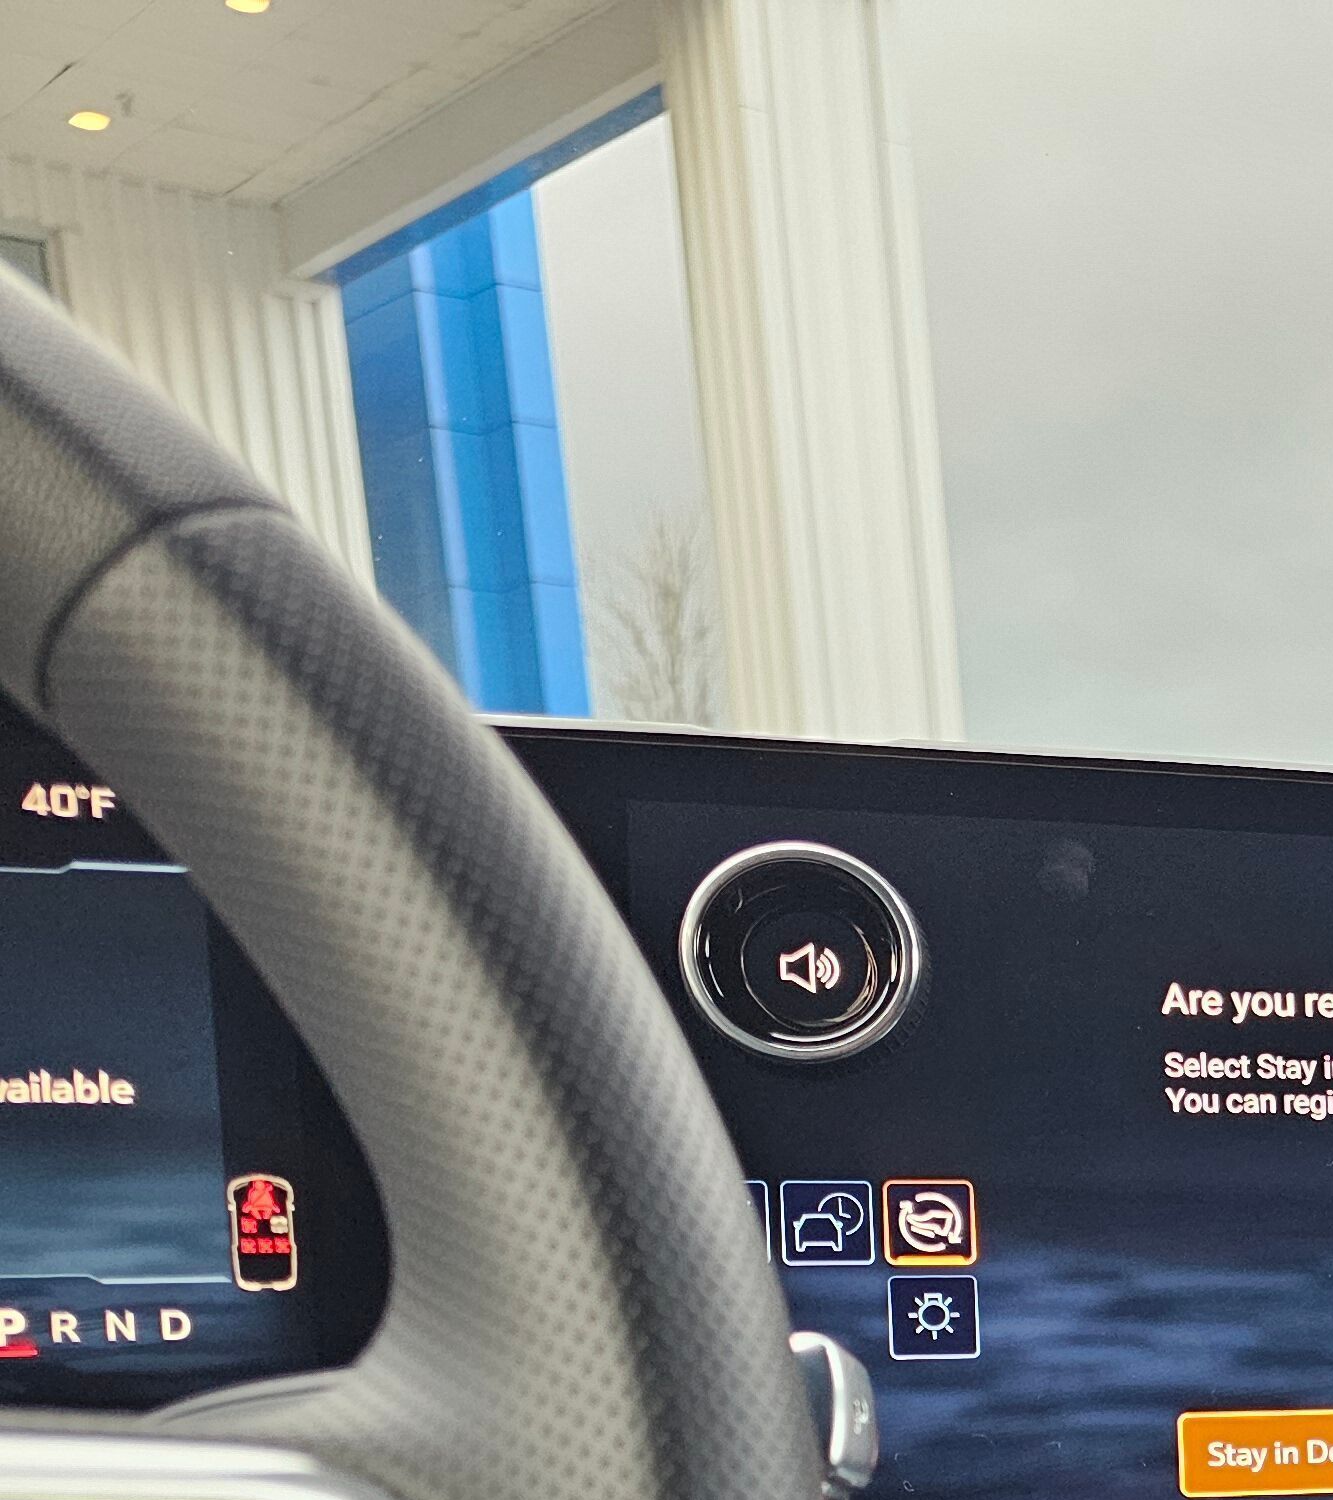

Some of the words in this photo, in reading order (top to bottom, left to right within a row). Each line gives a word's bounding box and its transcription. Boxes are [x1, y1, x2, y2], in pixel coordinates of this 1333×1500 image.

[1161, 982, 1223, 1016] Are
[1231, 991, 1295, 1024] you
[1164, 1052, 1251, 1079] Select
[1257, 1053, 1317, 1085] Stay
[1165, 1088, 1219, 1114] You
[1226, 1093, 1277, 1115] can
[0, 1308, 27, 1347] P
[50, 1311, 81, 1343] R
[105, 1309, 137, 1342] N
[160, 1309, 192, 1341] D
[1207, 1441, 1268, 1473] Stay
[1274, 1440, 1299, 1465] in
